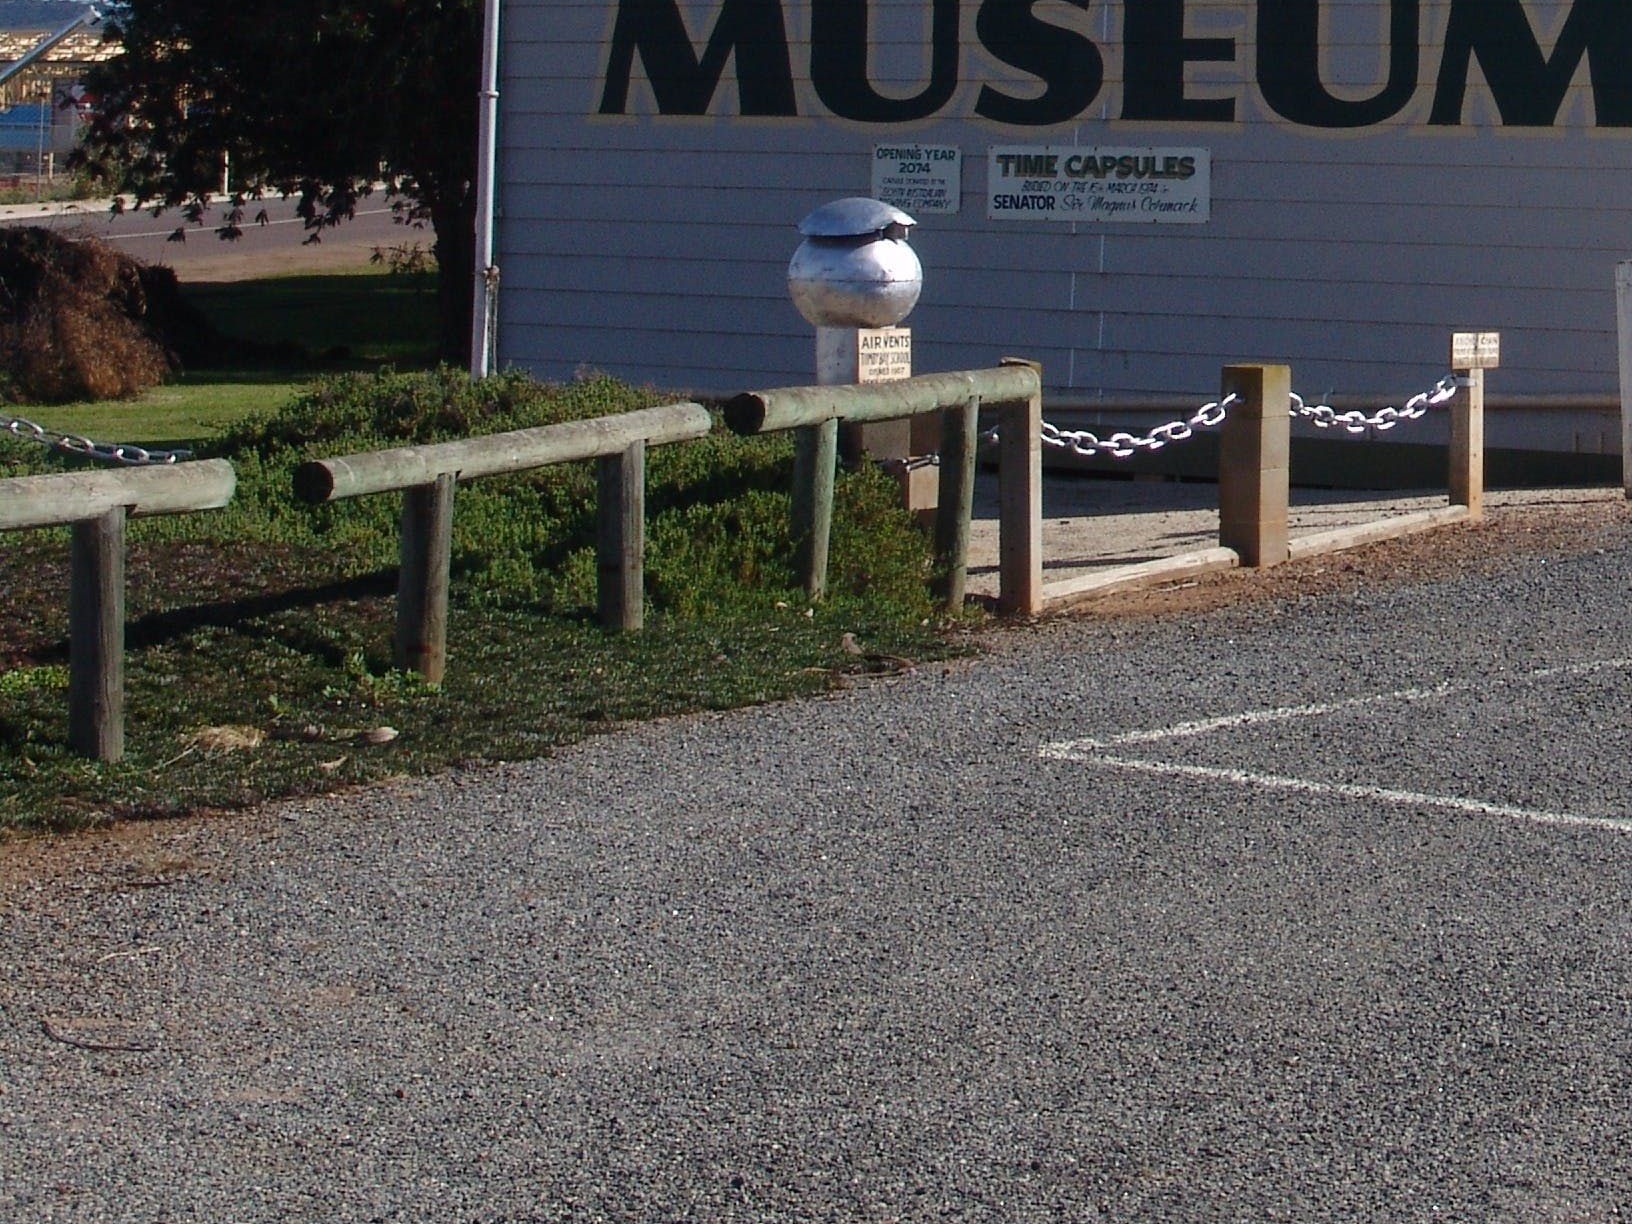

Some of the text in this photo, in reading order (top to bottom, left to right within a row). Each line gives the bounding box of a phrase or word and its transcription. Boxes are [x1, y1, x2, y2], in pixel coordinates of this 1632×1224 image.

[876, 148, 956, 161] OPENING YEAR
[899, 162, 931, 174] 2074
[996, 154, 1195, 180] TIME CAPSULES
[1053, 181, 1069, 193] ON
[1107, 182, 1137, 195] MARCH
[993, 194, 1198, 216] SENATOR Sir Magnus Cormack
[861, 335, 910, 350] AIR VENTS
